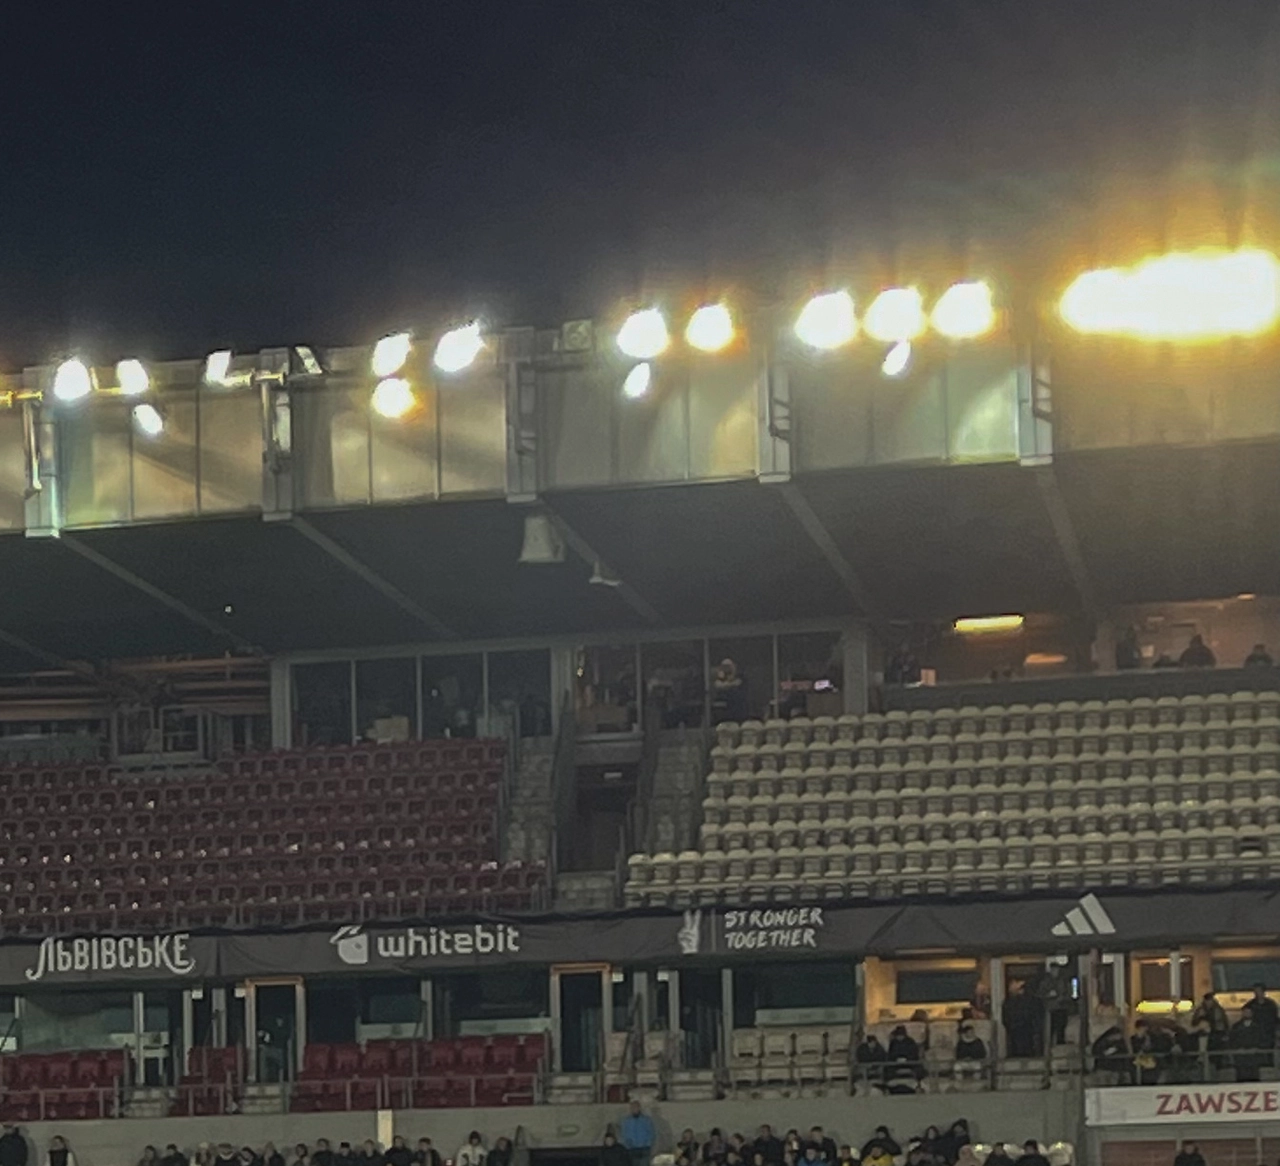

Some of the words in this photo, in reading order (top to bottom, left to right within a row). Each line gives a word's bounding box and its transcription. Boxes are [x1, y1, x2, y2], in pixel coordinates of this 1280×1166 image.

[724, 907, 824, 929] STRONGER
[377, 924, 520, 957] whitebit
[724, 928, 817, 949] TOGETHER
[25, 933, 196, 981] ЛЬВІВСЬКЕ
[1156, 1091, 1279, 1116] ZAWSZE
